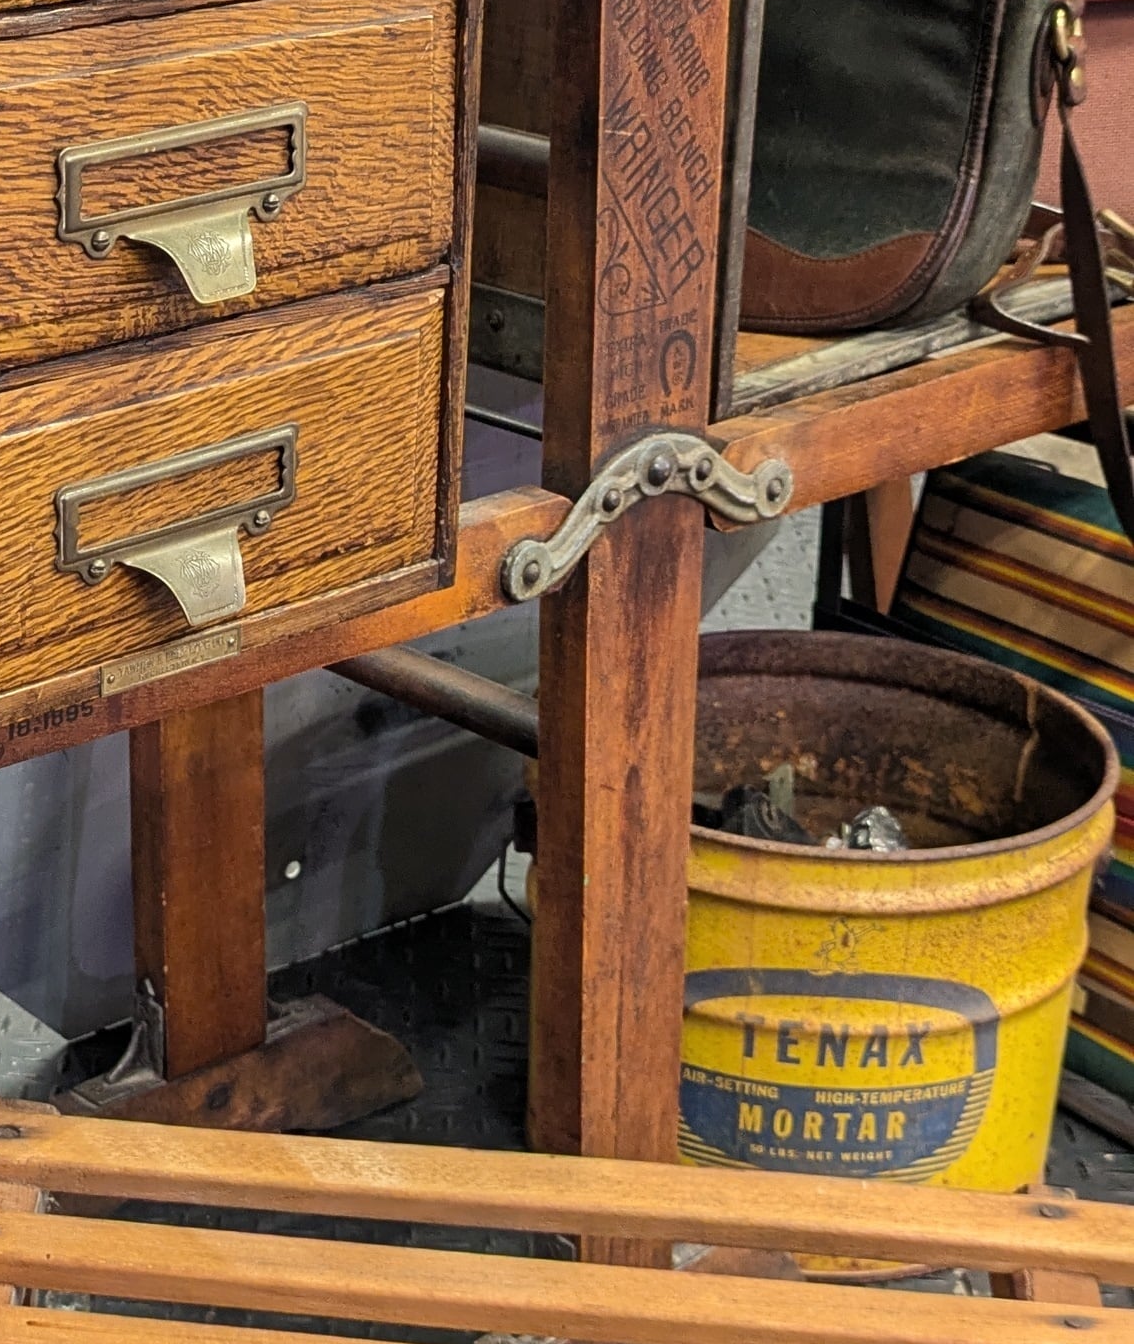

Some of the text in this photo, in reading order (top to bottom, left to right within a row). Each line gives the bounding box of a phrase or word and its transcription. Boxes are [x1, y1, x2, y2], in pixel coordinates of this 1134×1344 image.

[659, 96, 716, 203] BENCH
[604, 70, 706, 297] WRINGER
[736, 1012, 933, 1069] TENAX
[681, 1066, 966, 1106] AIR-SETTING HIGH-TEMPERATURE
[738, 1101, 908, 1142] MORTAR
[805, 1149, 834, 1162] NET
[840, 1149, 894, 1162] WEIGHT
